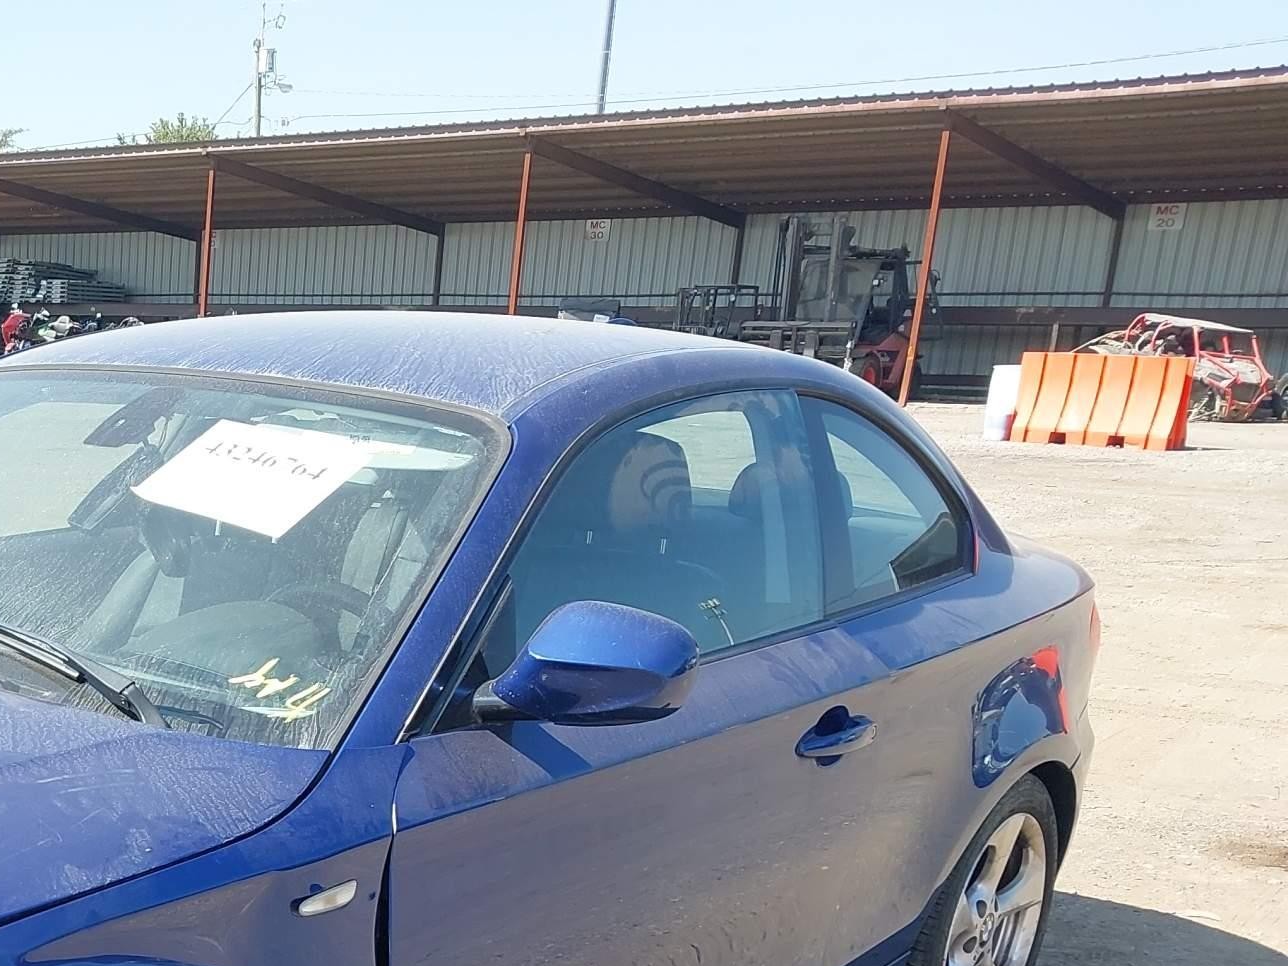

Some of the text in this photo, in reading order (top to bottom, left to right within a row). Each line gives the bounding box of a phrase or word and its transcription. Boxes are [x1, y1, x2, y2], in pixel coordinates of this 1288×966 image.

[1156, 205, 1180, 215] MC
[590, 220, 606, 230] MC
[1156, 218, 1176, 228] 20
[590, 231, 604, 240] 30
